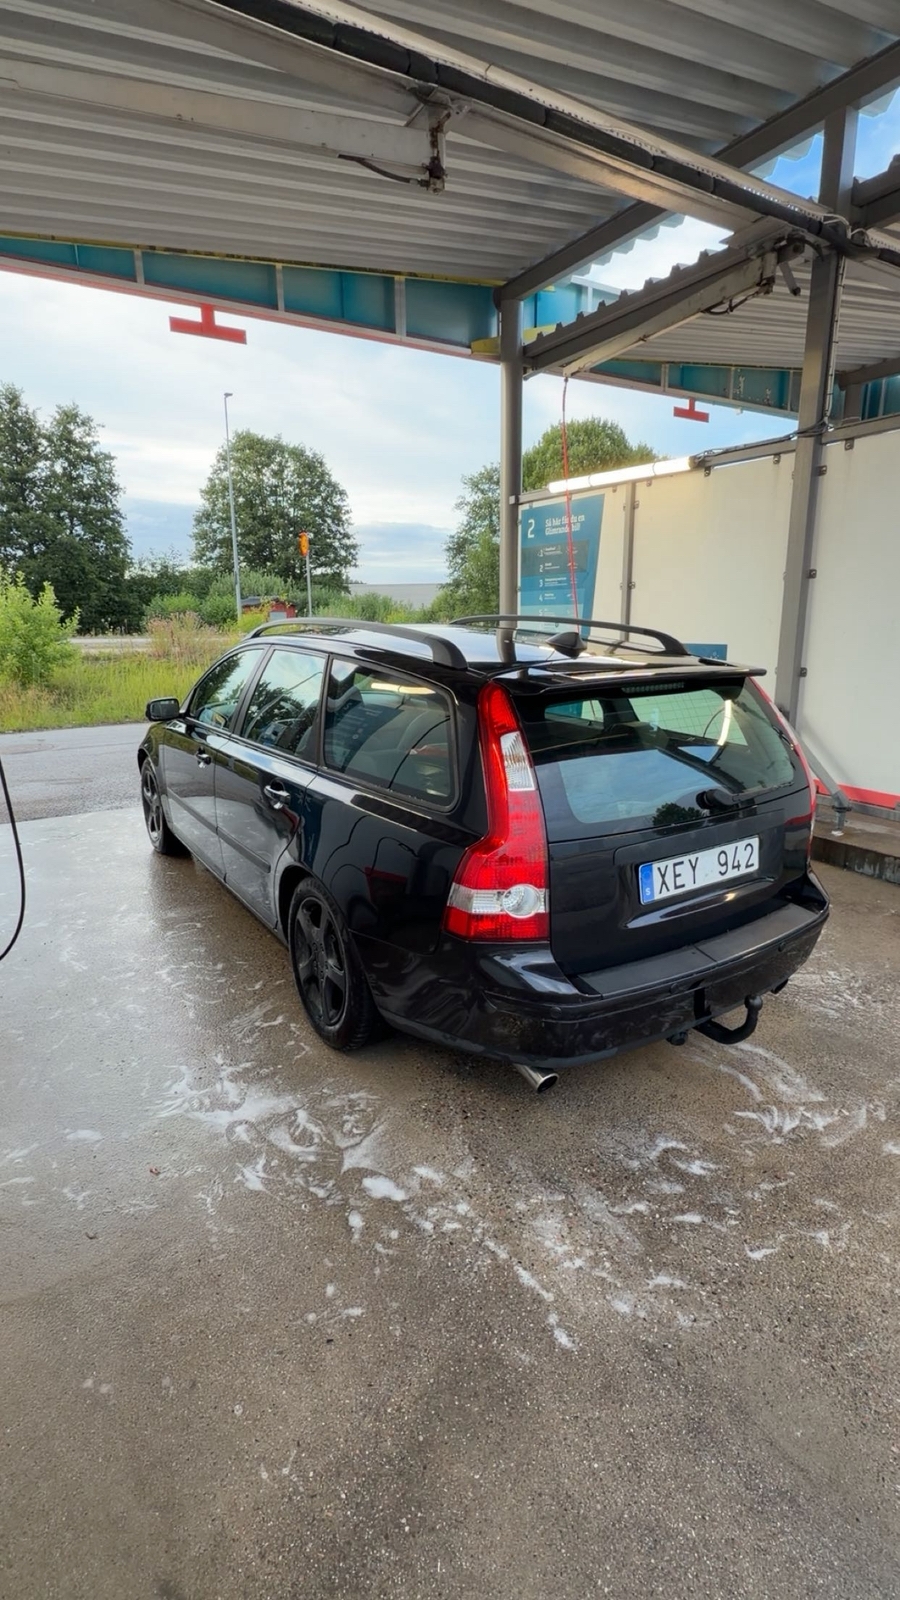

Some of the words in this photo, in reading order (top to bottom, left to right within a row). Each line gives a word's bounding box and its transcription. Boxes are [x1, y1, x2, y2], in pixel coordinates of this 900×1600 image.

[527, 519, 535, 539] 2
[657, 856, 699, 895] XEY
[717, 842, 755, 876] 942
[645, 887, 651, 896] S
